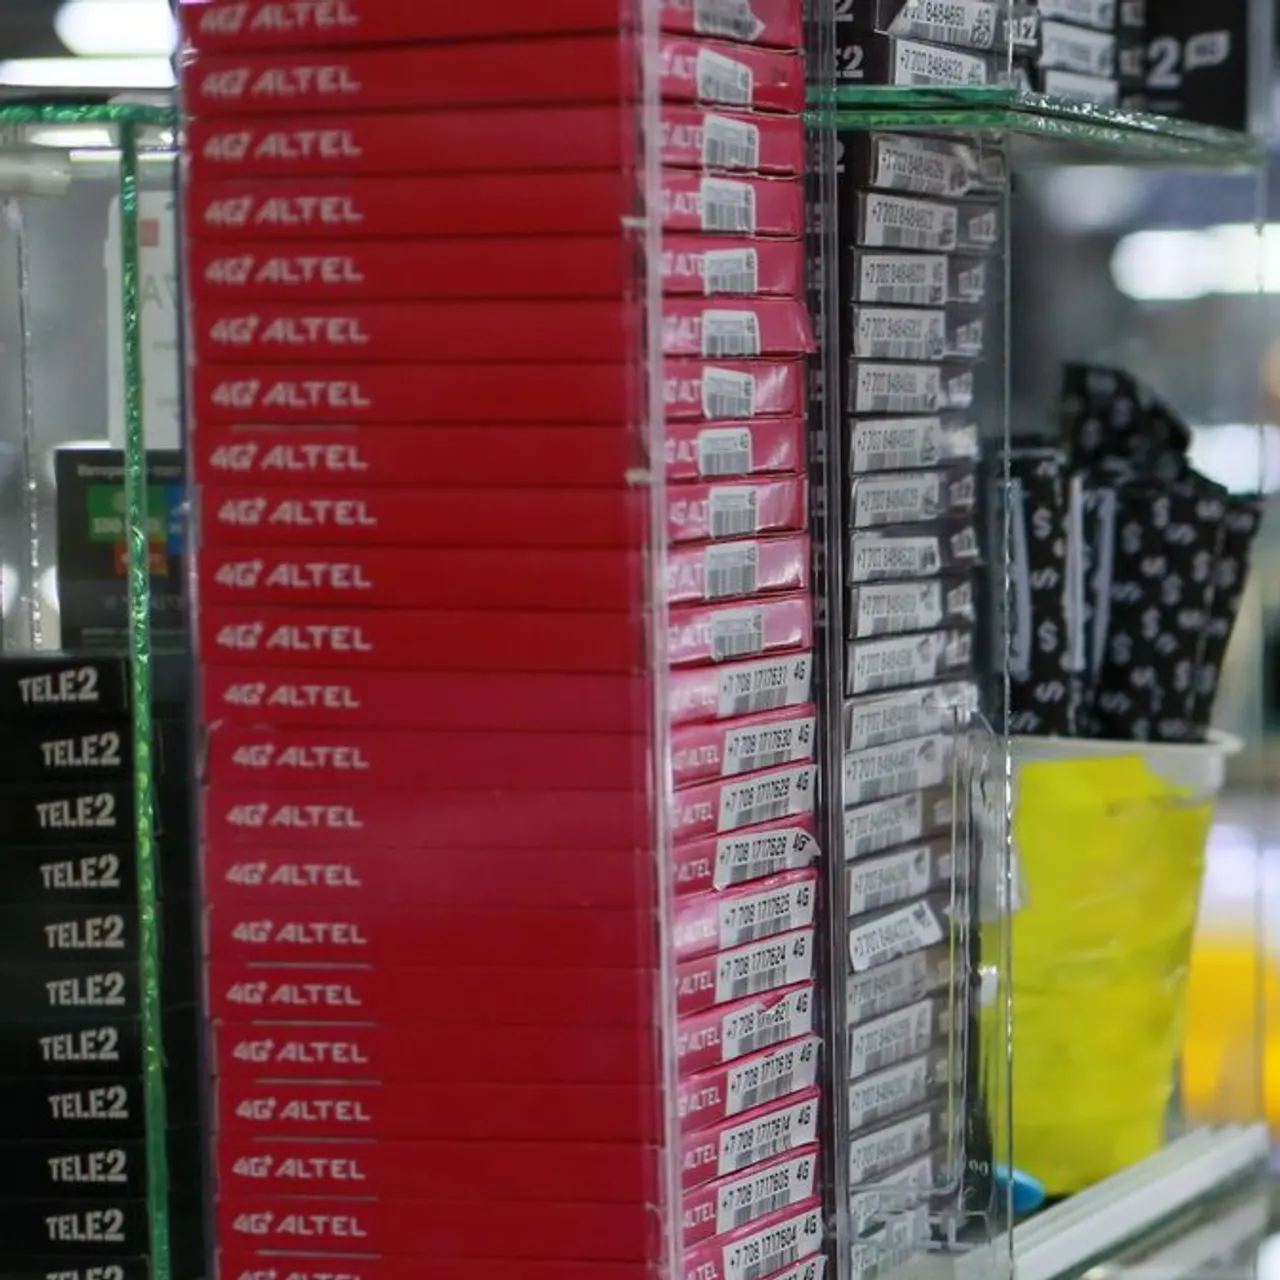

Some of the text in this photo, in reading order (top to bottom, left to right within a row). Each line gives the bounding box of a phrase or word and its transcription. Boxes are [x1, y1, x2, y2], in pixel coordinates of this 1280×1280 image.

[250, 1, 359, 31] ALTEL
[255, 66, 358, 93] ALTEL
[257, 131, 362, 157] ALTEL
[258, 196, 363, 222] ALTEL
[258, 256, 364, 282] ALTEL
[262, 317, 369, 343] ALTEL
[264, 381, 370, 406] ALTEL
[262, 444, 368, 470] ALTEL
[270, 500, 378, 525] ALTEL
[267, 563, 372, 588] ALTEL
[267, 625, 373, 651] ALTEL
[18, 667, 99, 703] TELE2
[269, 685, 360, 708] ALTEL
[41, 731, 120, 766] TELE2
[277, 746, 370, 768] ALTEL
[36, 791, 116, 827] TELE2
[271, 805, 363, 828] ALTEL
[40, 852, 120, 888] TELE2
[269, 864, 361, 886] ALTEL
[45, 913, 125, 948] TELE2
[276, 922, 367, 944] ALTEL
[45, 971, 126, 1005] TELE2
[270, 984, 362, 1006] ALTEL
[39, 1026, 119, 1061] TELE2
[277, 1042, 368, 1063] ALTEL
[48, 1084, 129, 1119] TELE2
[280, 1100, 371, 1121] ALTEL
[48, 1148, 128, 1182] TELE2
[275, 1158, 367, 1180] ALTEL
[45, 1207, 125, 1242] TELE2
[276, 1215, 368, 1237] ALTEL
